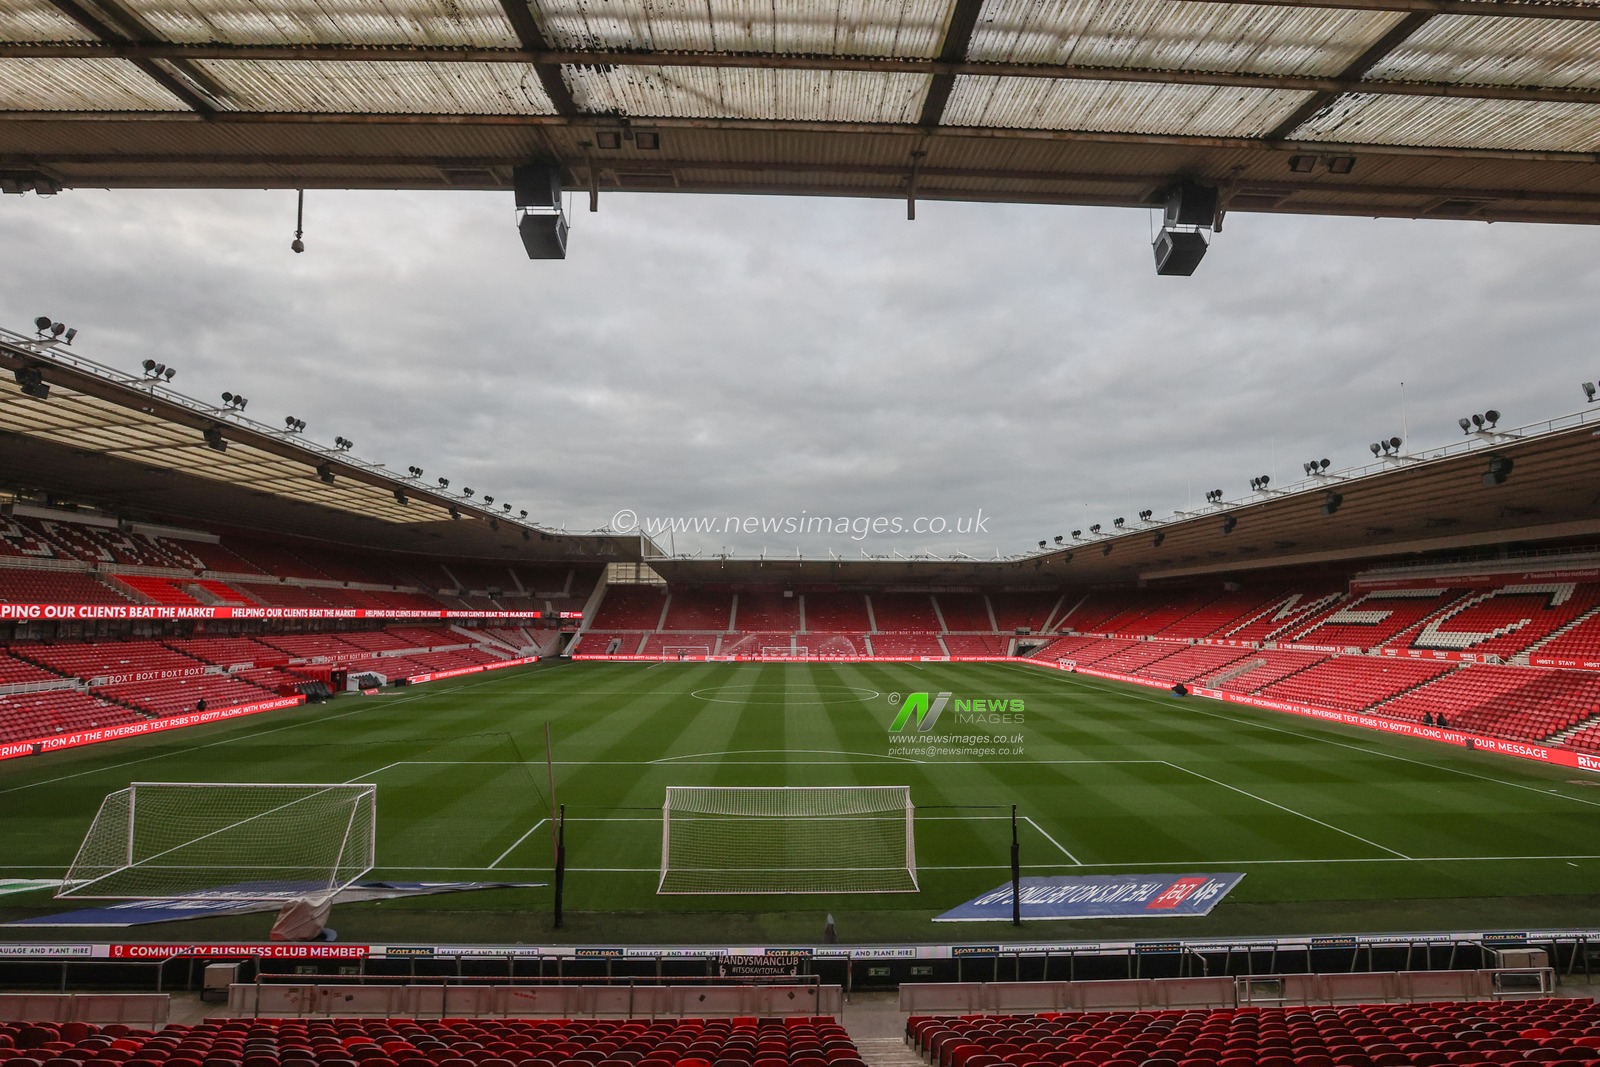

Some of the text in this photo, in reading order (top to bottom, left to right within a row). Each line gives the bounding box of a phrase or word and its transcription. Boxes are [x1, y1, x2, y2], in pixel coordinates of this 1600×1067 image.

[1556, 569, 1598, 578] International
[0, 606, 215, 618] PING OUR CLIENTS BEAT THE MARKET
[232, 608, 264, 617] HELPING
[266, 608, 282, 617] OUR
[284, 609, 308, 617] CLIENTS
[110, 667, 204, 684] BOXT BOXT BOXT BOXT
[0, 738, 67, 756] RIMINTION
[69, 735, 82, 744] AT
[84, 732, 101, 741] THE
[104, 724, 148, 738] RIVERSIDE
[150, 720, 168, 730] TEXT
[170, 717, 189, 727] RSBS
[201, 712, 220, 721] 60777
[220, 708, 242, 718] ALONG
[243, 705, 257, 713] WITH
[258, 702, 274, 711] YOUR
[275, 698, 298, 708] MESSAGE
[1236, 696, 1252, 704] REPORT
[1254, 698, 1292, 710] DISCRIMINATION
[1312, 709, 1342, 720] RIVERSIDE
[1344, 714, 1359, 723] TEXT
[1360, 717, 1377, 727] RSBS
[1378, 720, 1388, 729] TO
[1390, 722, 1411, 733] 60777
[1413, 727, 1441, 738] ALONG
[1443, 733, 1466, 743] WITH
[1498, 743, 1548, 758] MESSAGE
[1158, 881, 1197, 905] bet
[1189, 878, 1226, 906] sky
[130, 946, 365, 957] COMMUNITY BUSINESS CLUB MEMBER
[718, 955, 798, 966] #ANDYSMANCLUB
